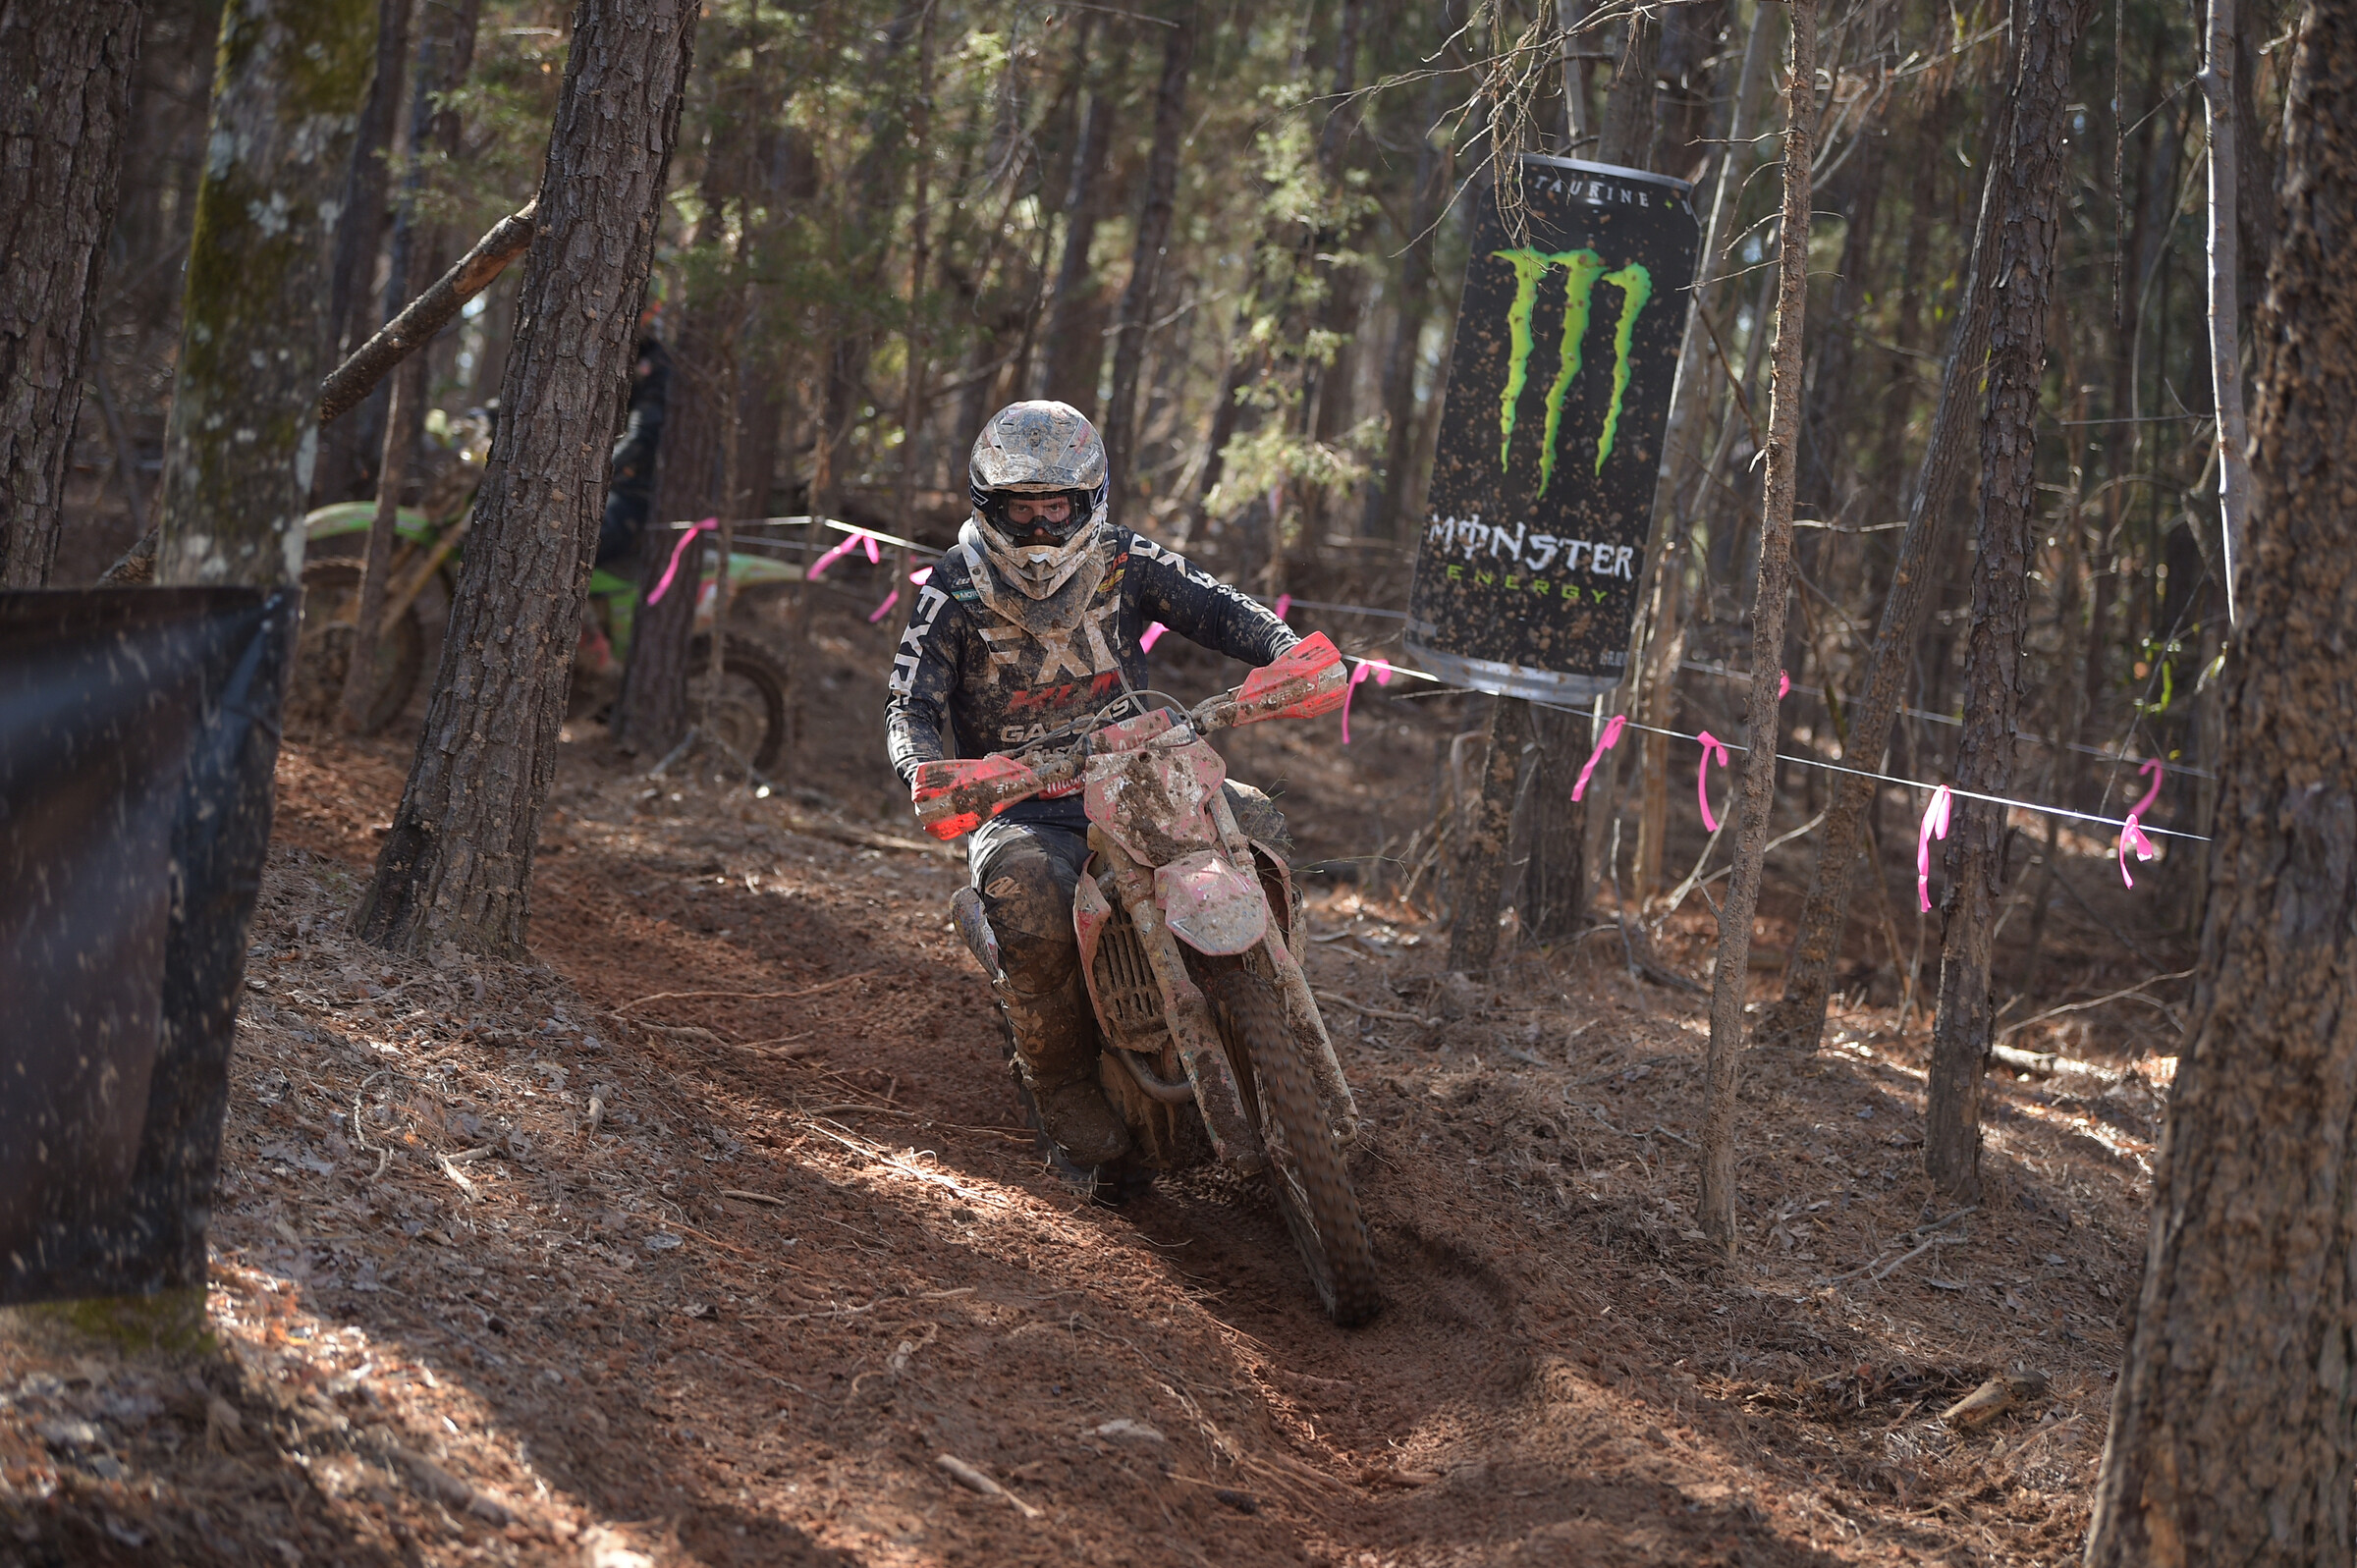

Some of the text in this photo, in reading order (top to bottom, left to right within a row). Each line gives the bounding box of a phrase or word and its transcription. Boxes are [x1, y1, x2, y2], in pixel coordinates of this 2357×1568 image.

[1533, 175, 1650, 208] TAURINE
[1429, 513, 1634, 582] MONSTER
[1446, 564, 1609, 605] ENERGY
[888, 585, 950, 690] FXR
